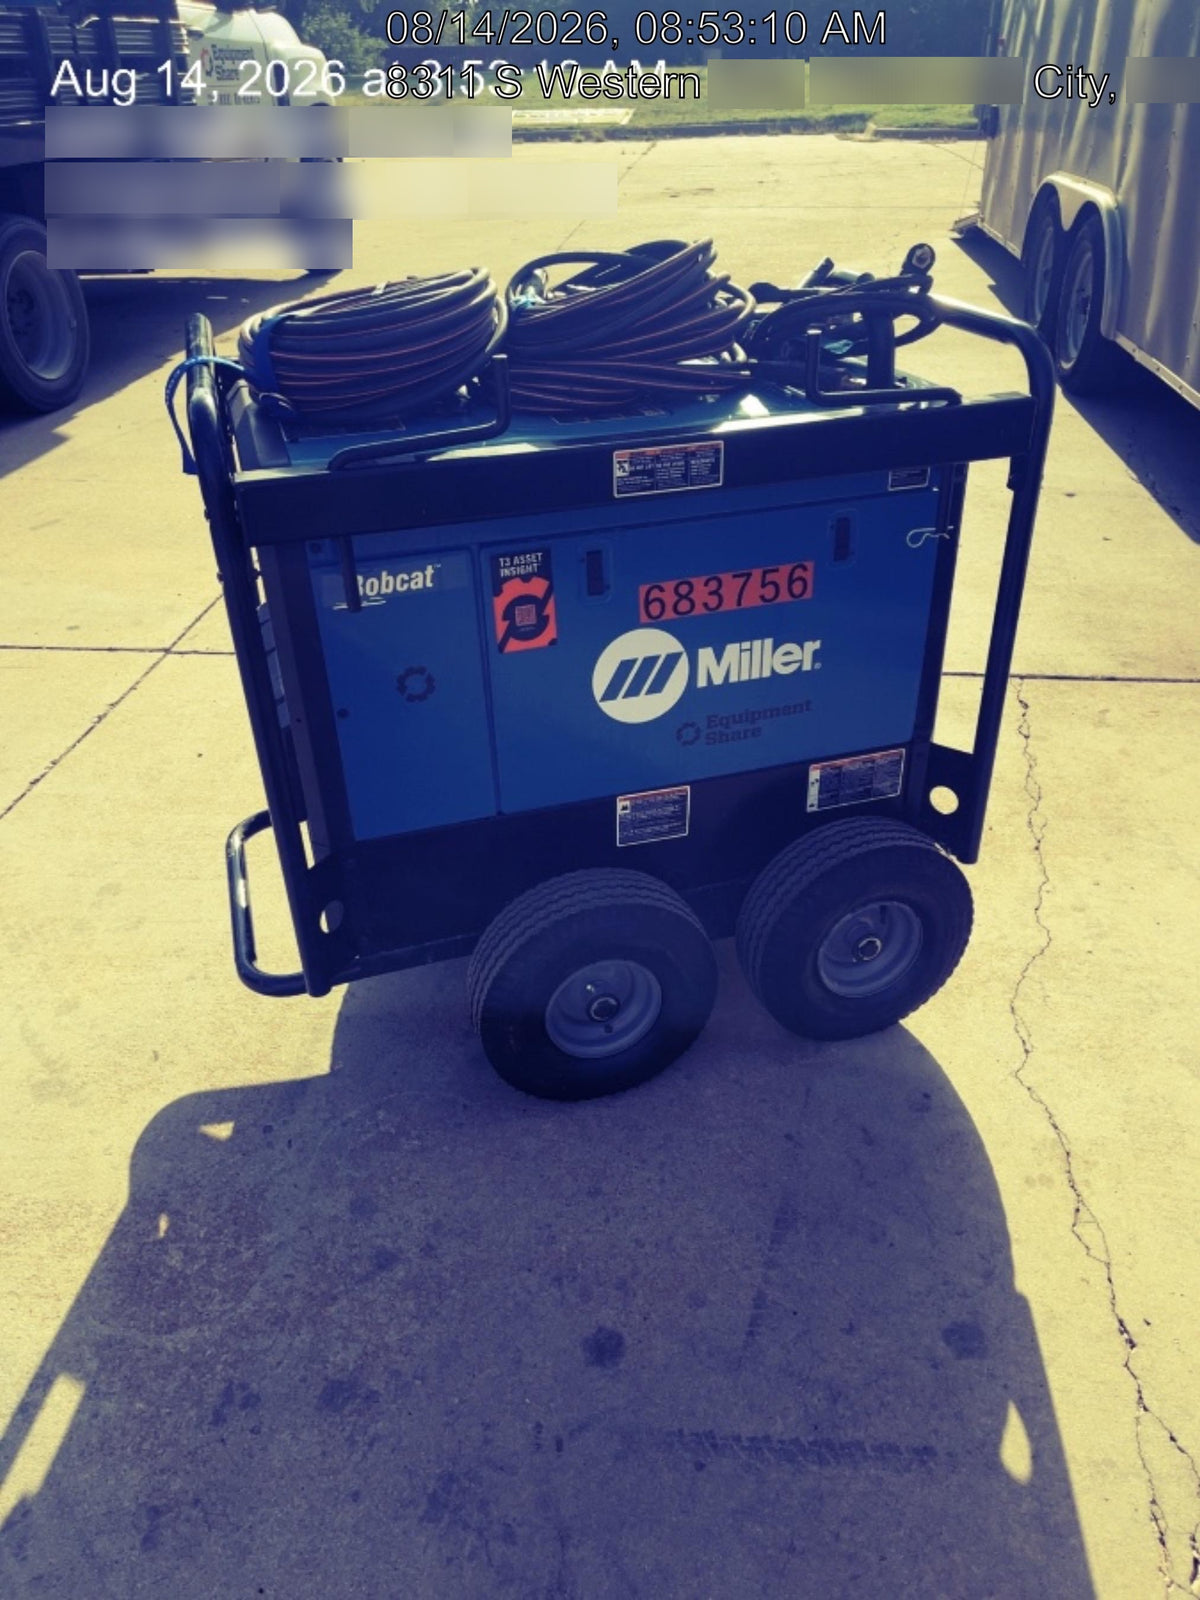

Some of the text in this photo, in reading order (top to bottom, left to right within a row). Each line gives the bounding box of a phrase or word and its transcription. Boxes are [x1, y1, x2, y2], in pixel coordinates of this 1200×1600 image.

[499, 552, 543, 567] T3 ASSET
[499, 563, 538, 578] INSIGHT
[643, 563, 808, 620] 683756
[706, 700, 812, 729] Equipment
[705, 726, 762, 746] Share
